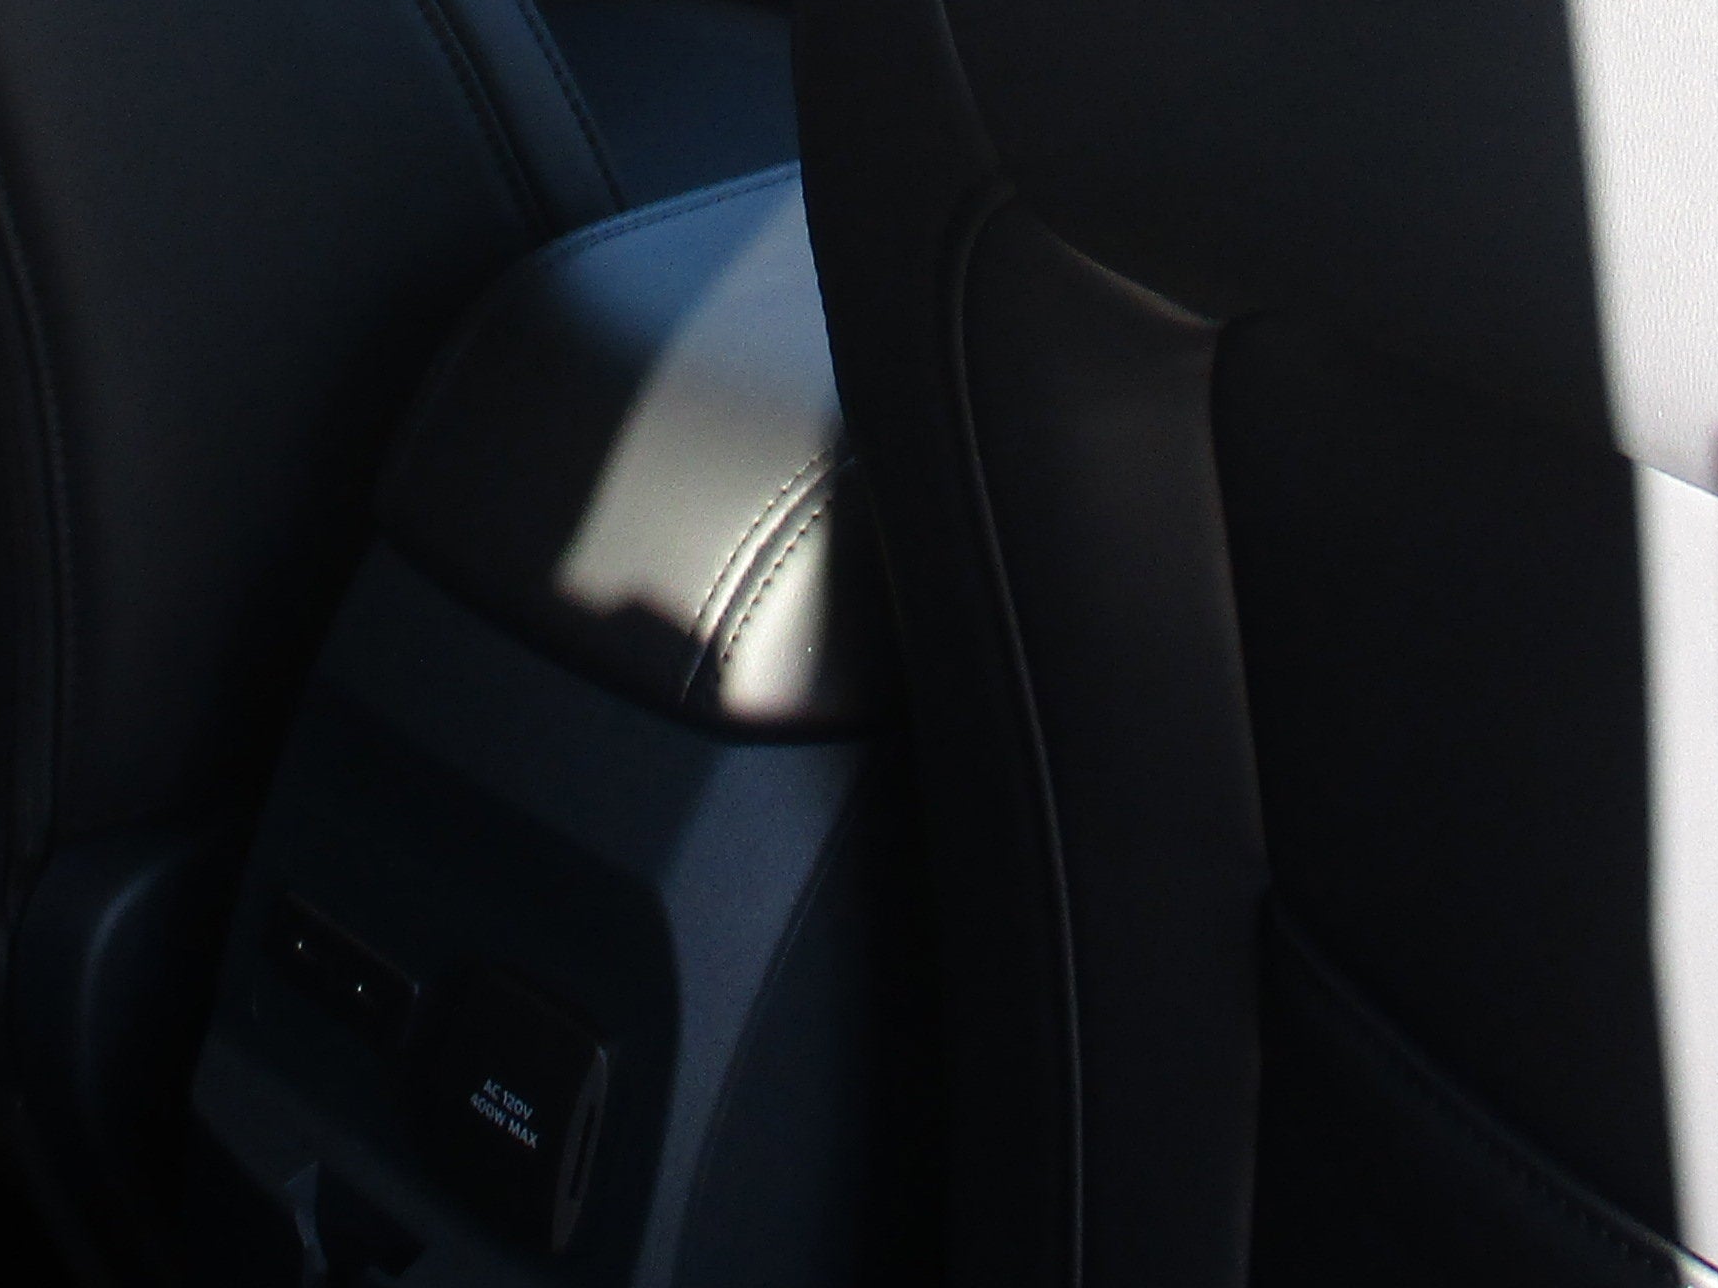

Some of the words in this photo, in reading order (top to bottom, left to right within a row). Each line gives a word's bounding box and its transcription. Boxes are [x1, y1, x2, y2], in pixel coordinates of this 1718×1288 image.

[469, 1093, 506, 1126] 400W
[507, 1118, 539, 1149] MAX
[483, 1077, 502, 1101] AC
[502, 1090, 533, 1121] 120V
